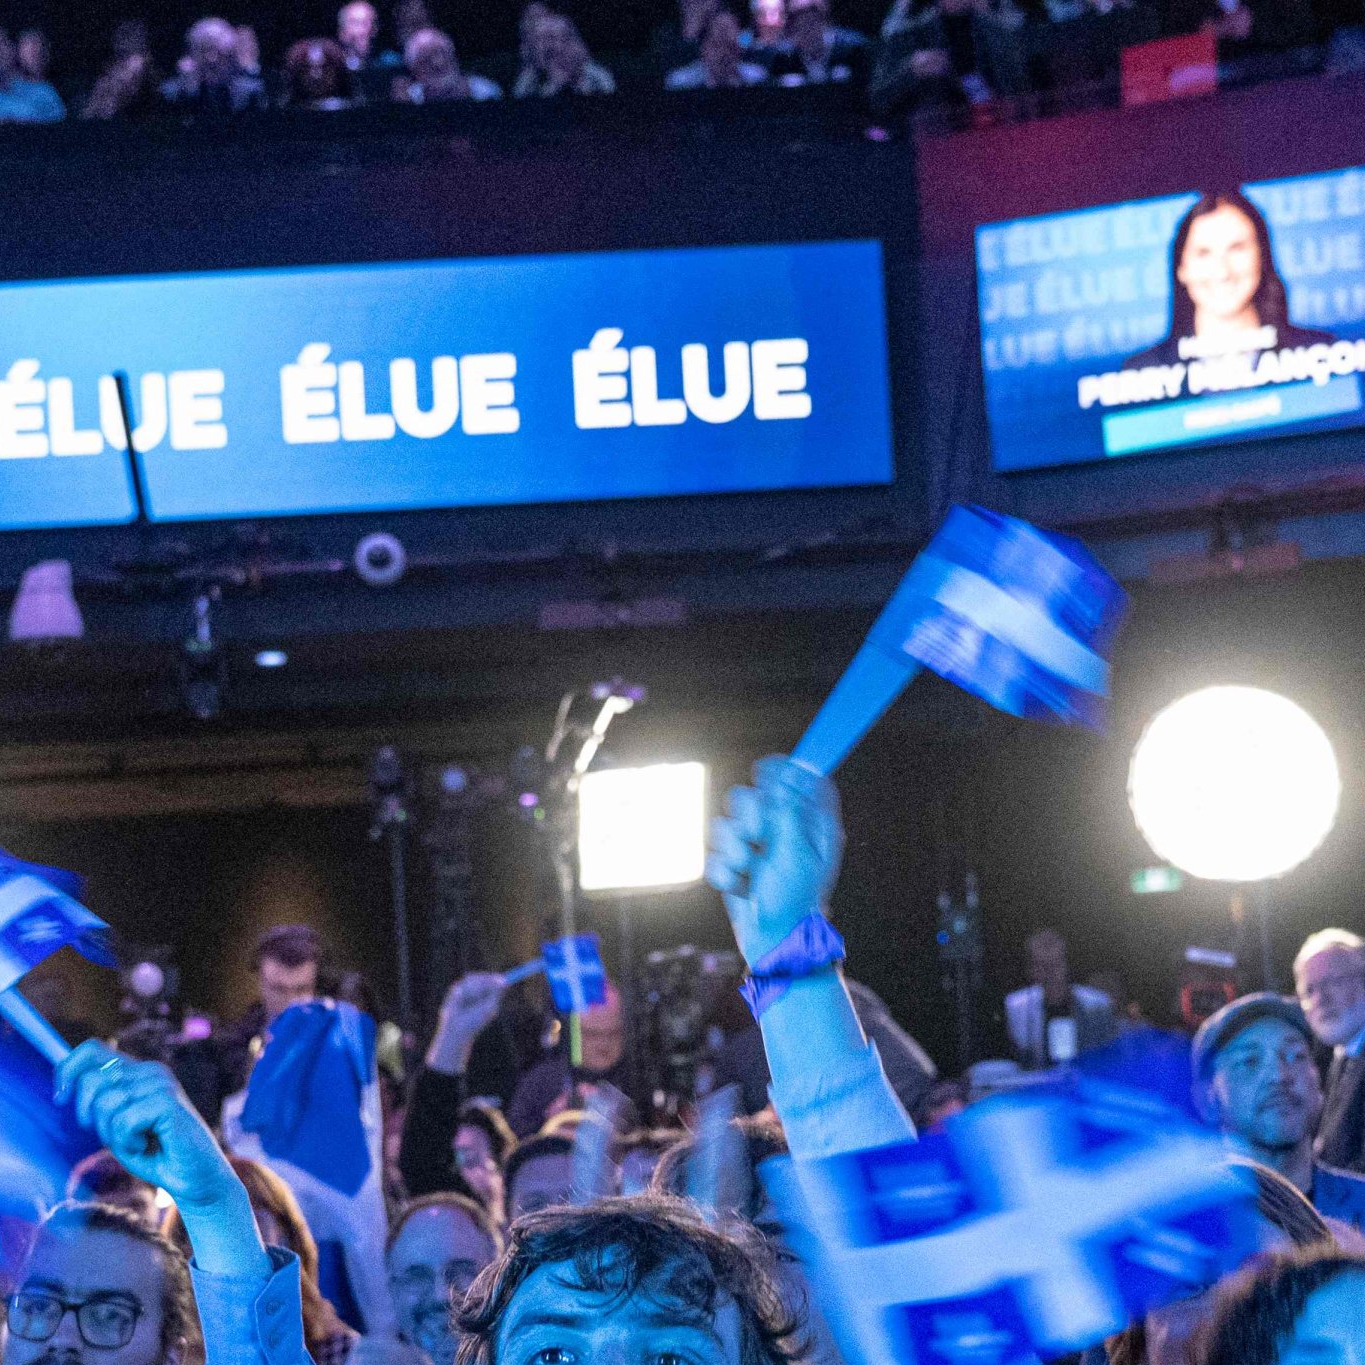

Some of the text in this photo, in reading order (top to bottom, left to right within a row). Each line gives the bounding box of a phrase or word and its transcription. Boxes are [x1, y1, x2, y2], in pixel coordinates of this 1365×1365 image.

[1035, 264, 1139, 315] ÉLUE
[279, 342, 520, 445] ÉLUE
[572, 328, 812, 429] ÉLUE
[1078, 362, 1187, 409] PERRY
